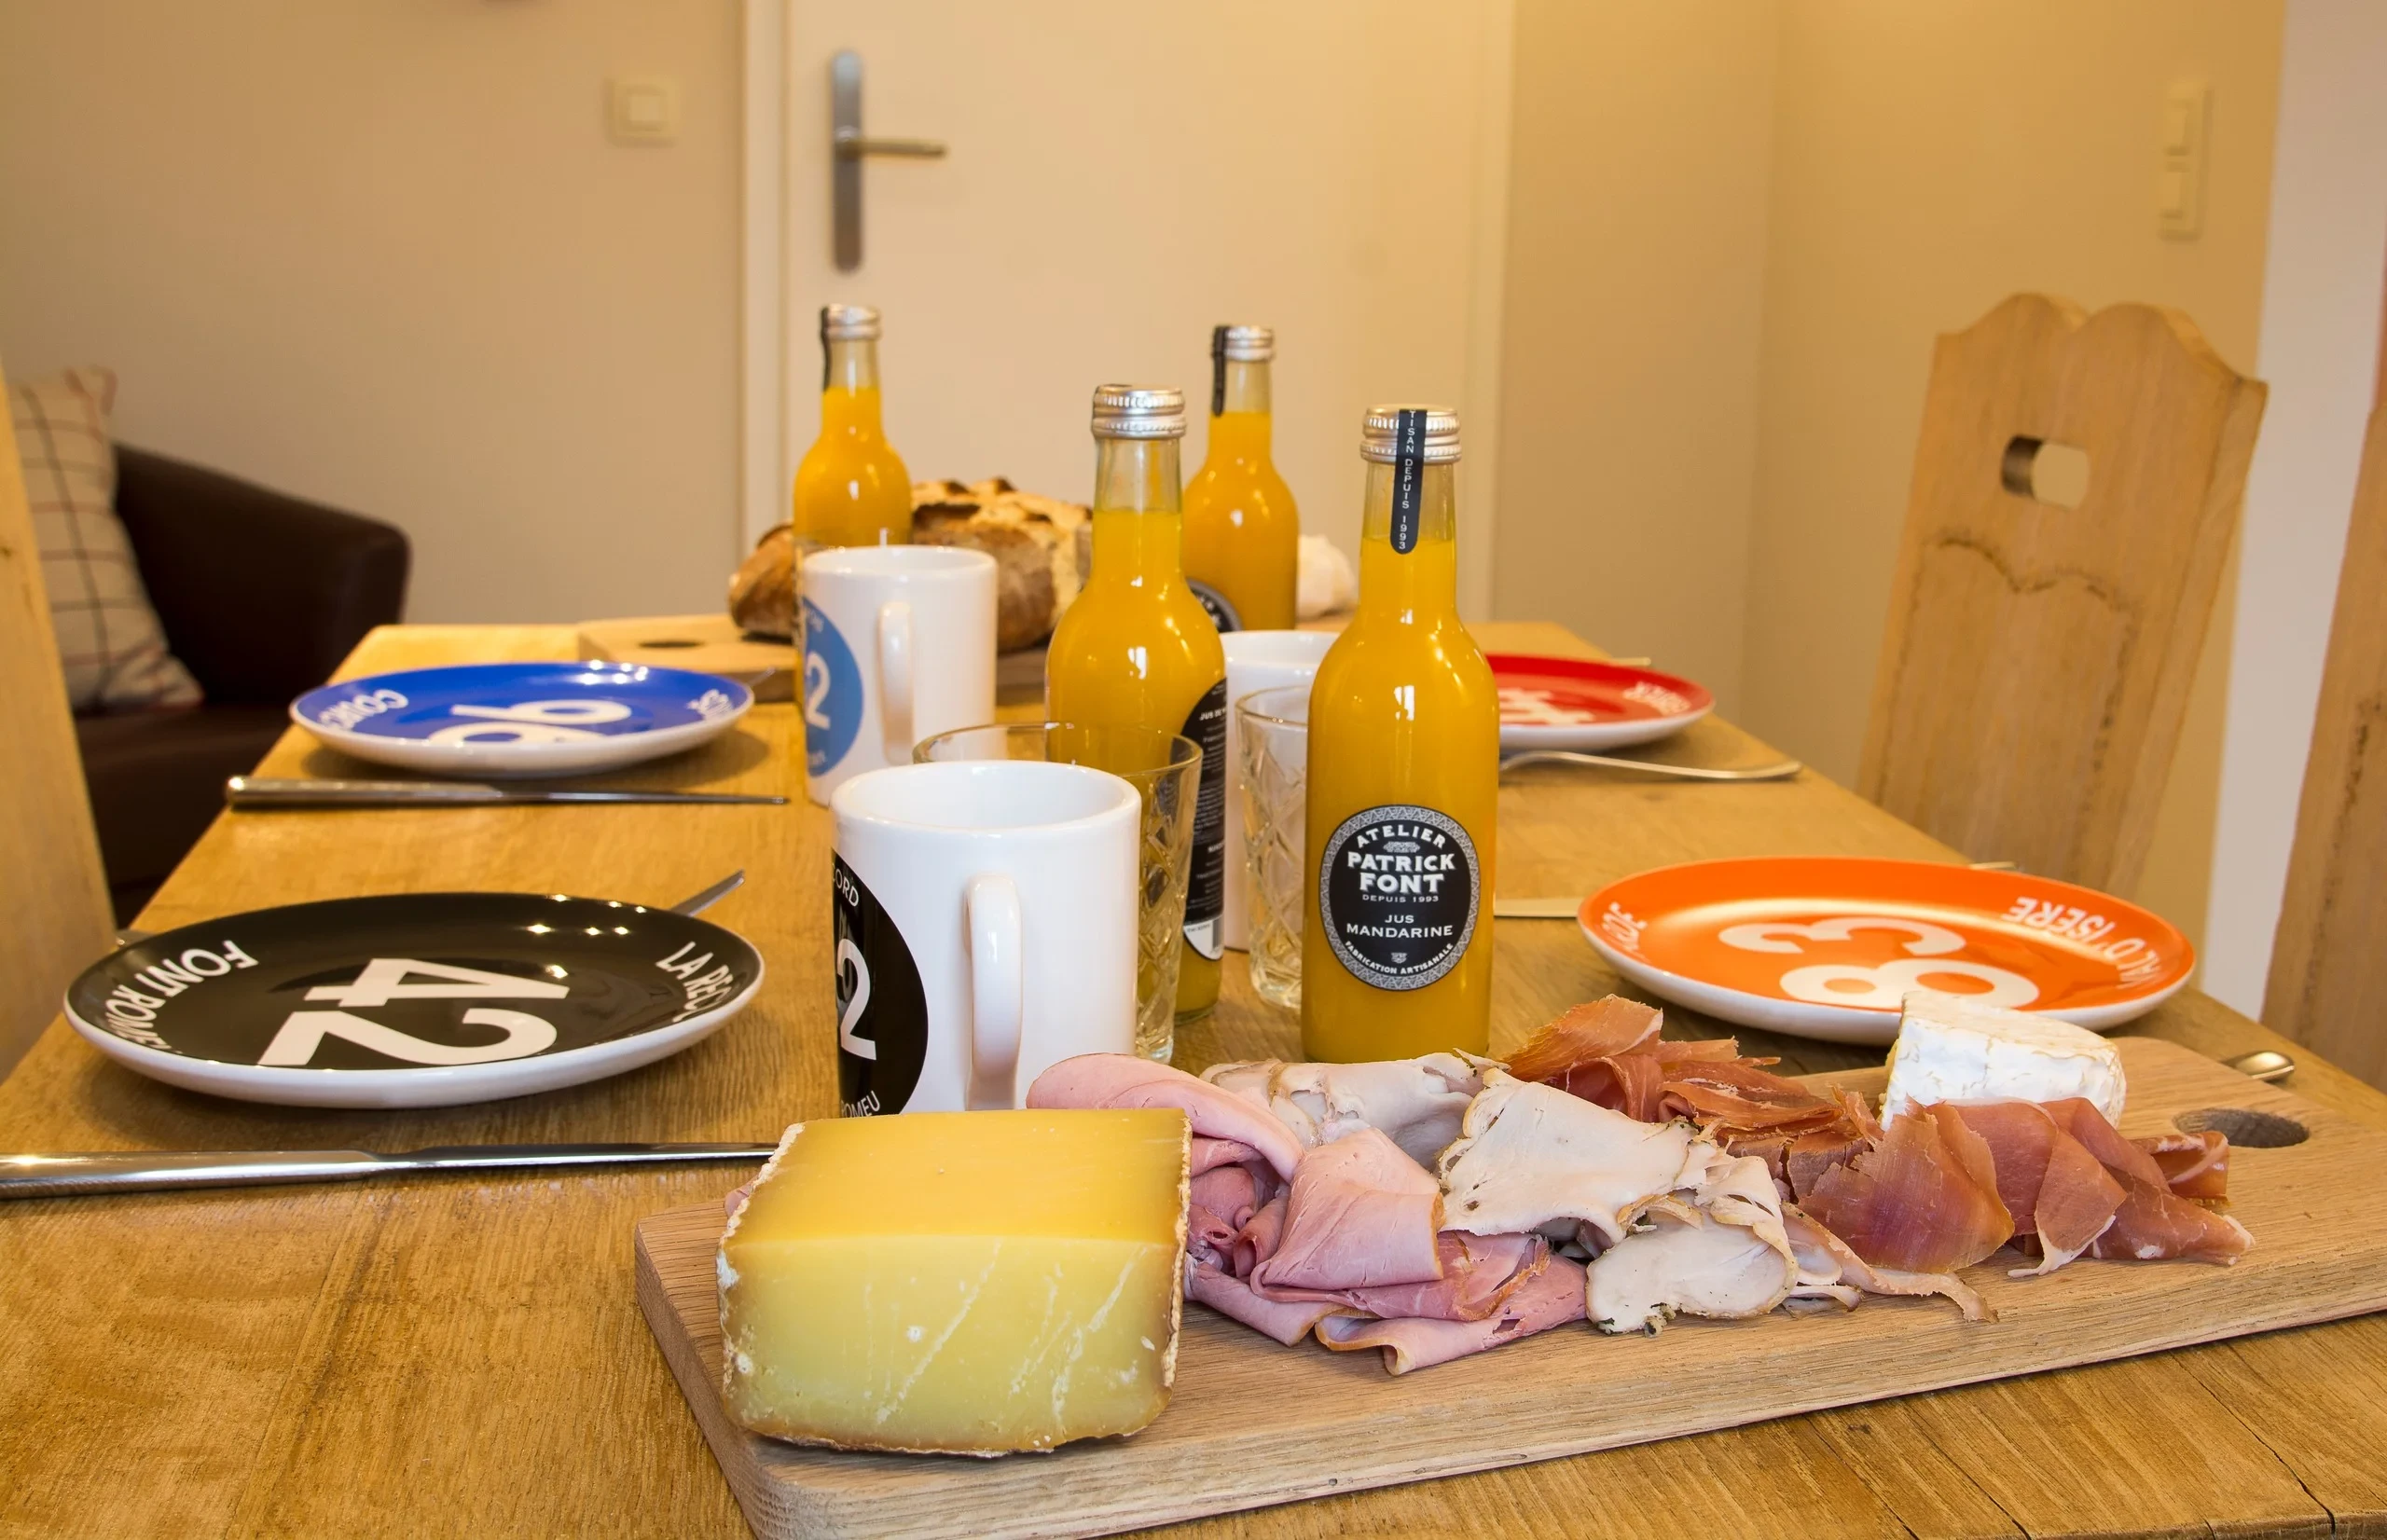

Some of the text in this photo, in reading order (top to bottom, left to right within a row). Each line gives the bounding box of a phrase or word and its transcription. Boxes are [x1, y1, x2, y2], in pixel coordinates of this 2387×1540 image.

[1402, 459, 1413, 509] DEPUIS
[1400, 516, 1408, 549] 1993
[1357, 824, 1446, 848] ATELIER
[1347, 851, 1456, 872] PATRICK
[833, 862, 859, 906] ORD
[1359, 873, 1444, 894] FONT
[1362, 894, 1406, 902] DEPUIS
[1346, 923, 1454, 939] MANDARINE
[1385, 914, 1414, 924] JUS
[655, 942, 713, 980] LA
[1345, 941, 1454, 974] FABRICATION ARTISANALE
[105, 940, 259, 1053] FONT ROME
[255, 958, 570, 1066] 42
